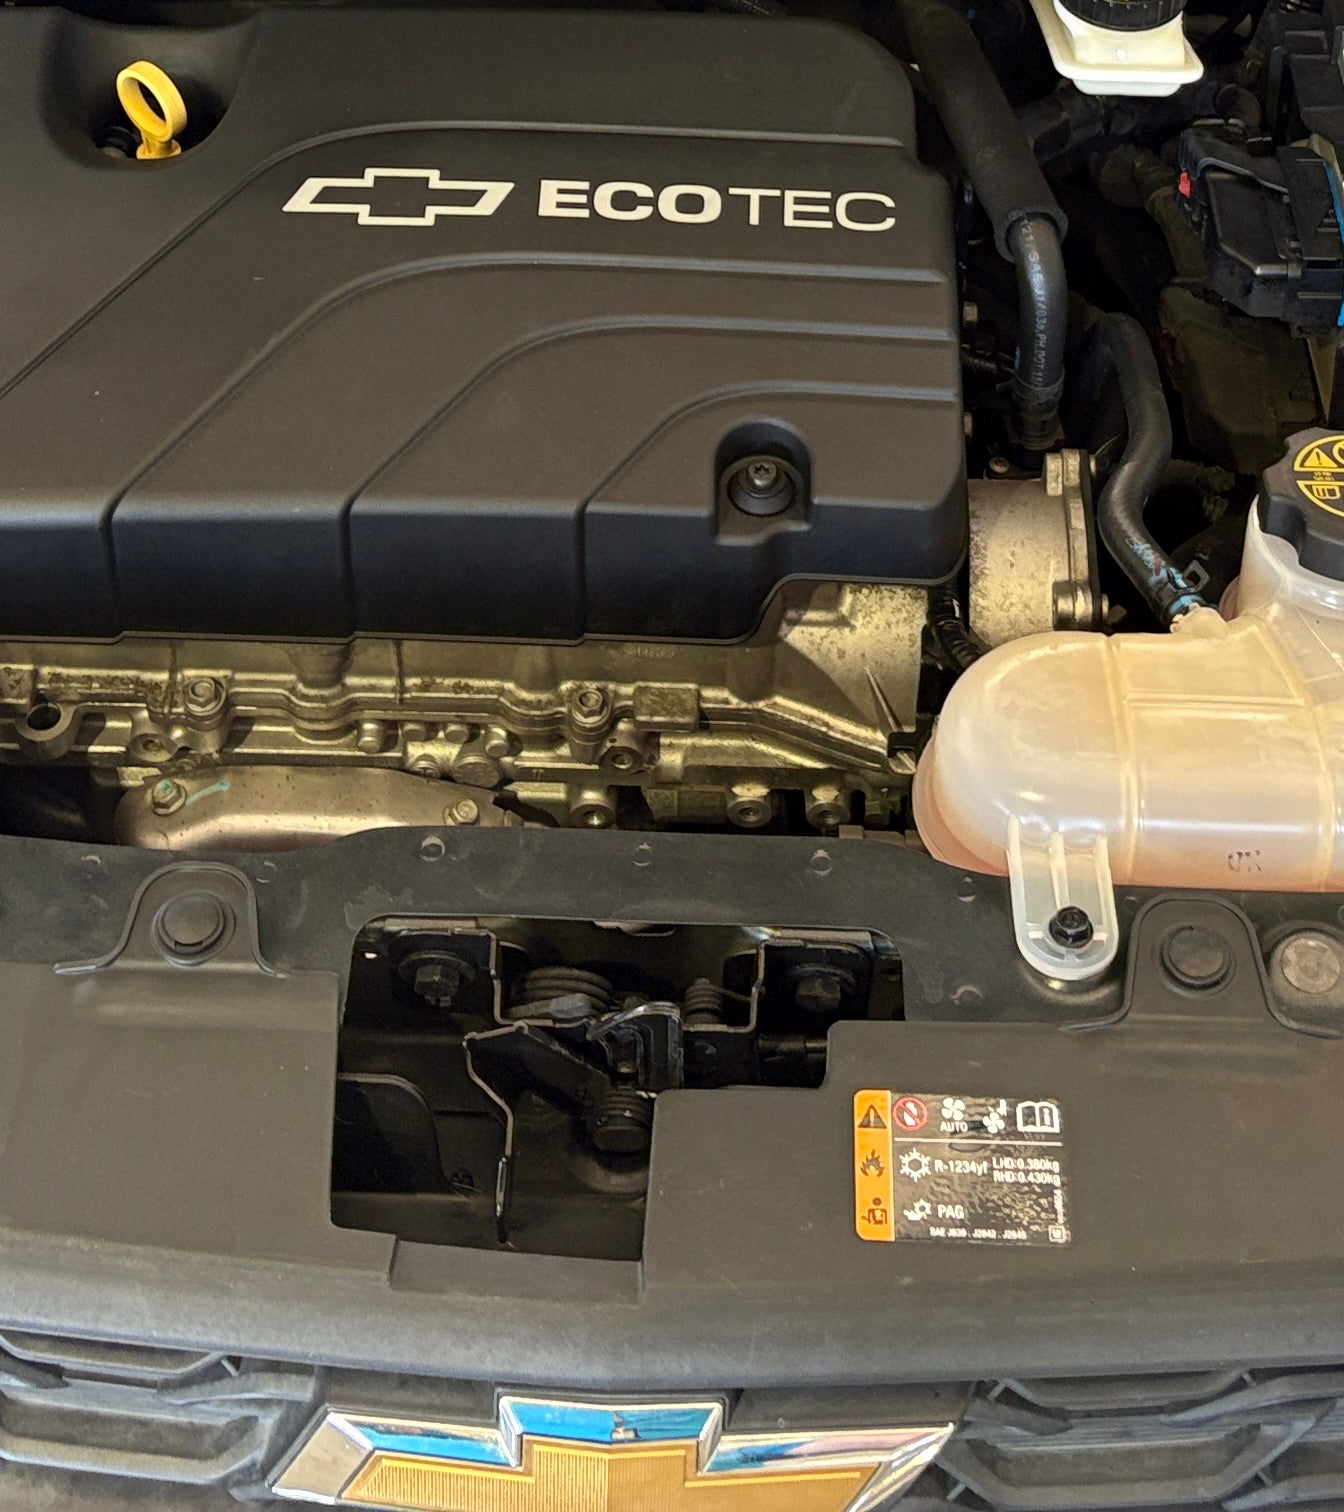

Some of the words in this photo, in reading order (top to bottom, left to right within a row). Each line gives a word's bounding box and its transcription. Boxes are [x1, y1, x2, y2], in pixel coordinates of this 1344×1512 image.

[537, 179, 897, 232] ECOTEC
[940, 1122, 969, 1133] AUTO
[937, 1204, 965, 1220] PAG
